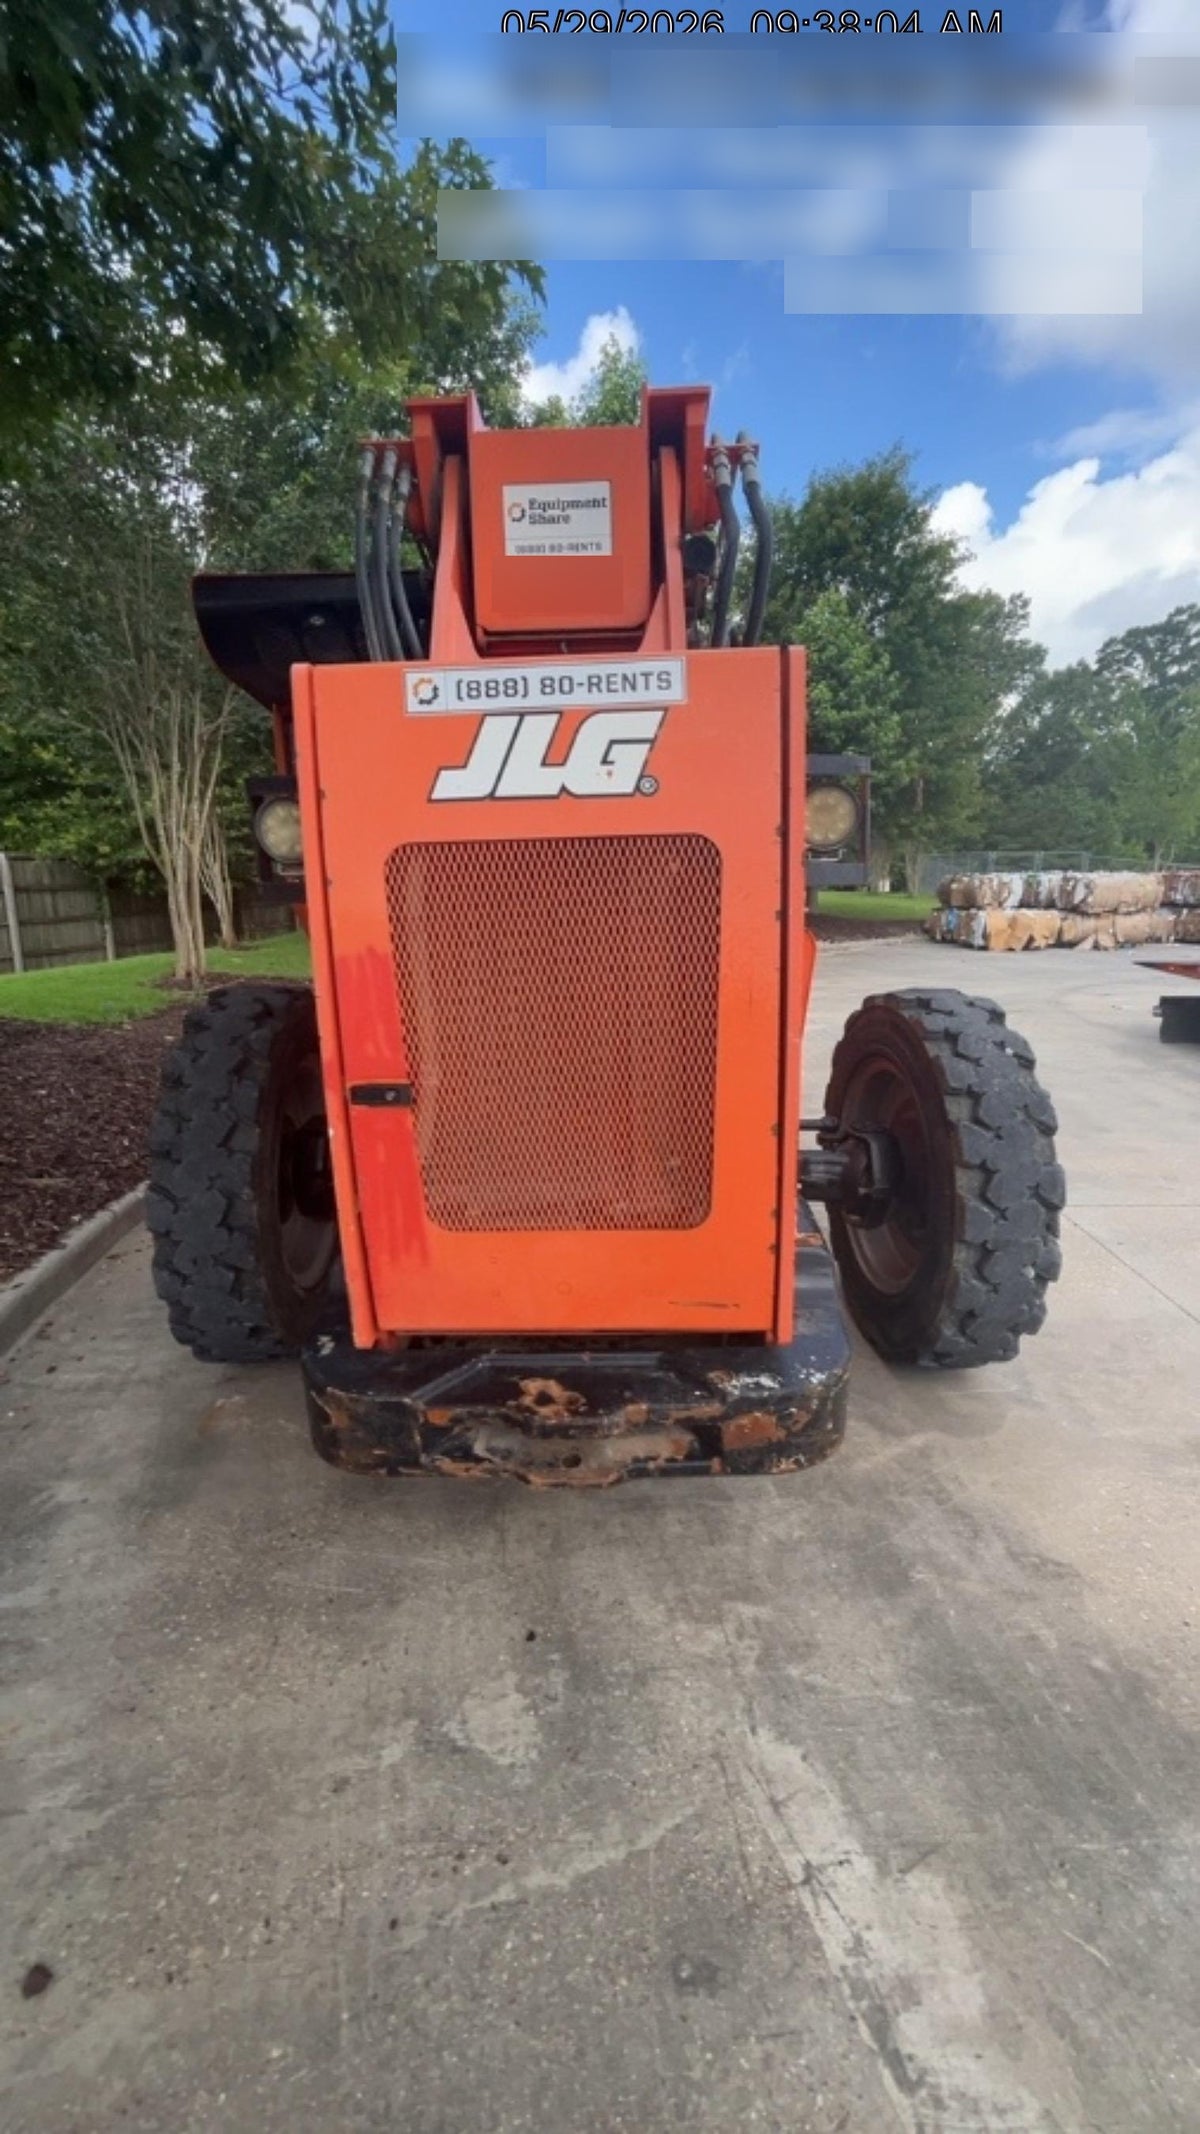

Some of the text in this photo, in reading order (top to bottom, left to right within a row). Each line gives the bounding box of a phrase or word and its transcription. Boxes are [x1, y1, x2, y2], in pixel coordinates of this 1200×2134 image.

[528, 497, 608, 512] Equipment
[528, 513, 571, 525] Share
[539, 670, 673, 697] 80-RENTS
[427, 709, 668, 802] JLG
